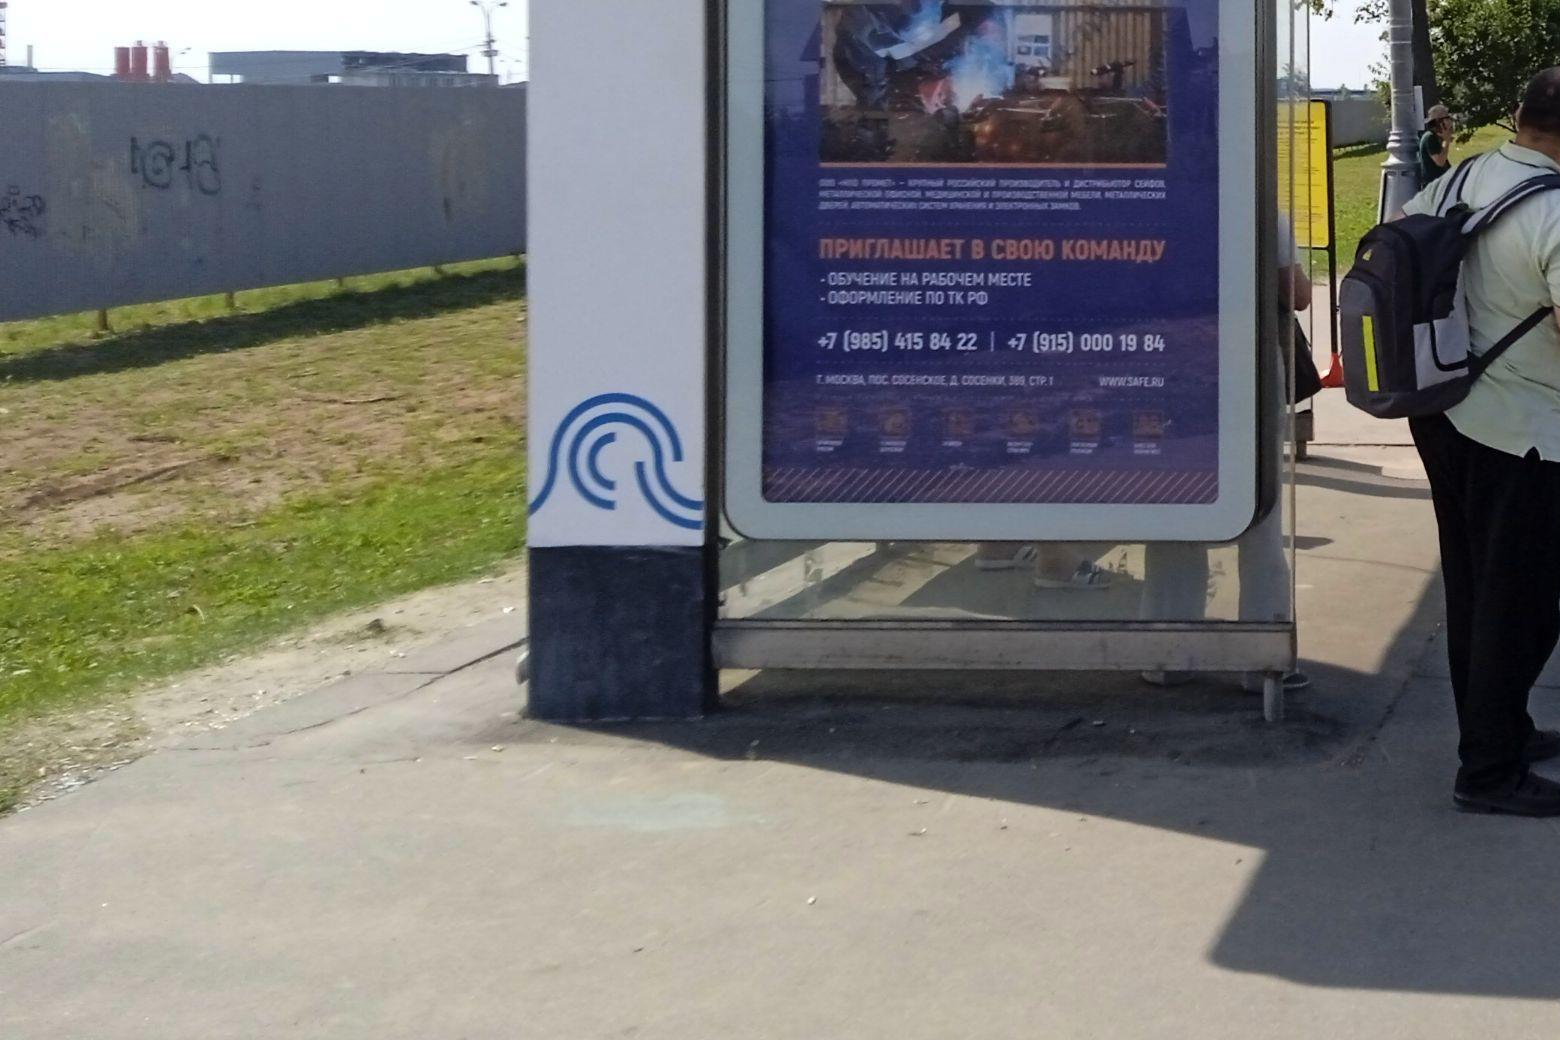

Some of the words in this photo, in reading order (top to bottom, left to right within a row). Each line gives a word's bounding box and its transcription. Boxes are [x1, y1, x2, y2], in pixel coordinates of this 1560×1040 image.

[819, 238, 965, 260] ПРИГЛАШАЕТ
[970, 239, 986, 260] В
[990, 239, 1055, 261] СВОЮ
[1061, 239, 1166, 264] КОМАНДУ
[828, 271, 898, 286] ОБУЧЕНИЕ
[901, 272, 919, 286] НА
[921, 272, 985, 287] РАБОЧЕМ
[987, 272, 1032, 287] МЕСТЕ
[828, 290, 923, 305] ОФОРМЛЕНИЕ
[925, 290, 945, 305] ПО
[947, 290, 965, 305] ТК
[967, 290, 989, 306] РФ
[817, 332, 838, 350] +7
[843, 330, 889, 353] (985)
[894, 332, 924, 351] 415
[929, 332, 952, 351] 84
[956, 332, 978, 351] 22
[1007, 333, 1027, 351] +7
[1032, 331, 1074, 354] (915)
[1080, 333, 1114, 352] 000
[1119, 333, 1138, 352] 19
[1143, 333, 1166, 352] 84
[1099, 376, 1165, 388] WWW.SAFE.RU
